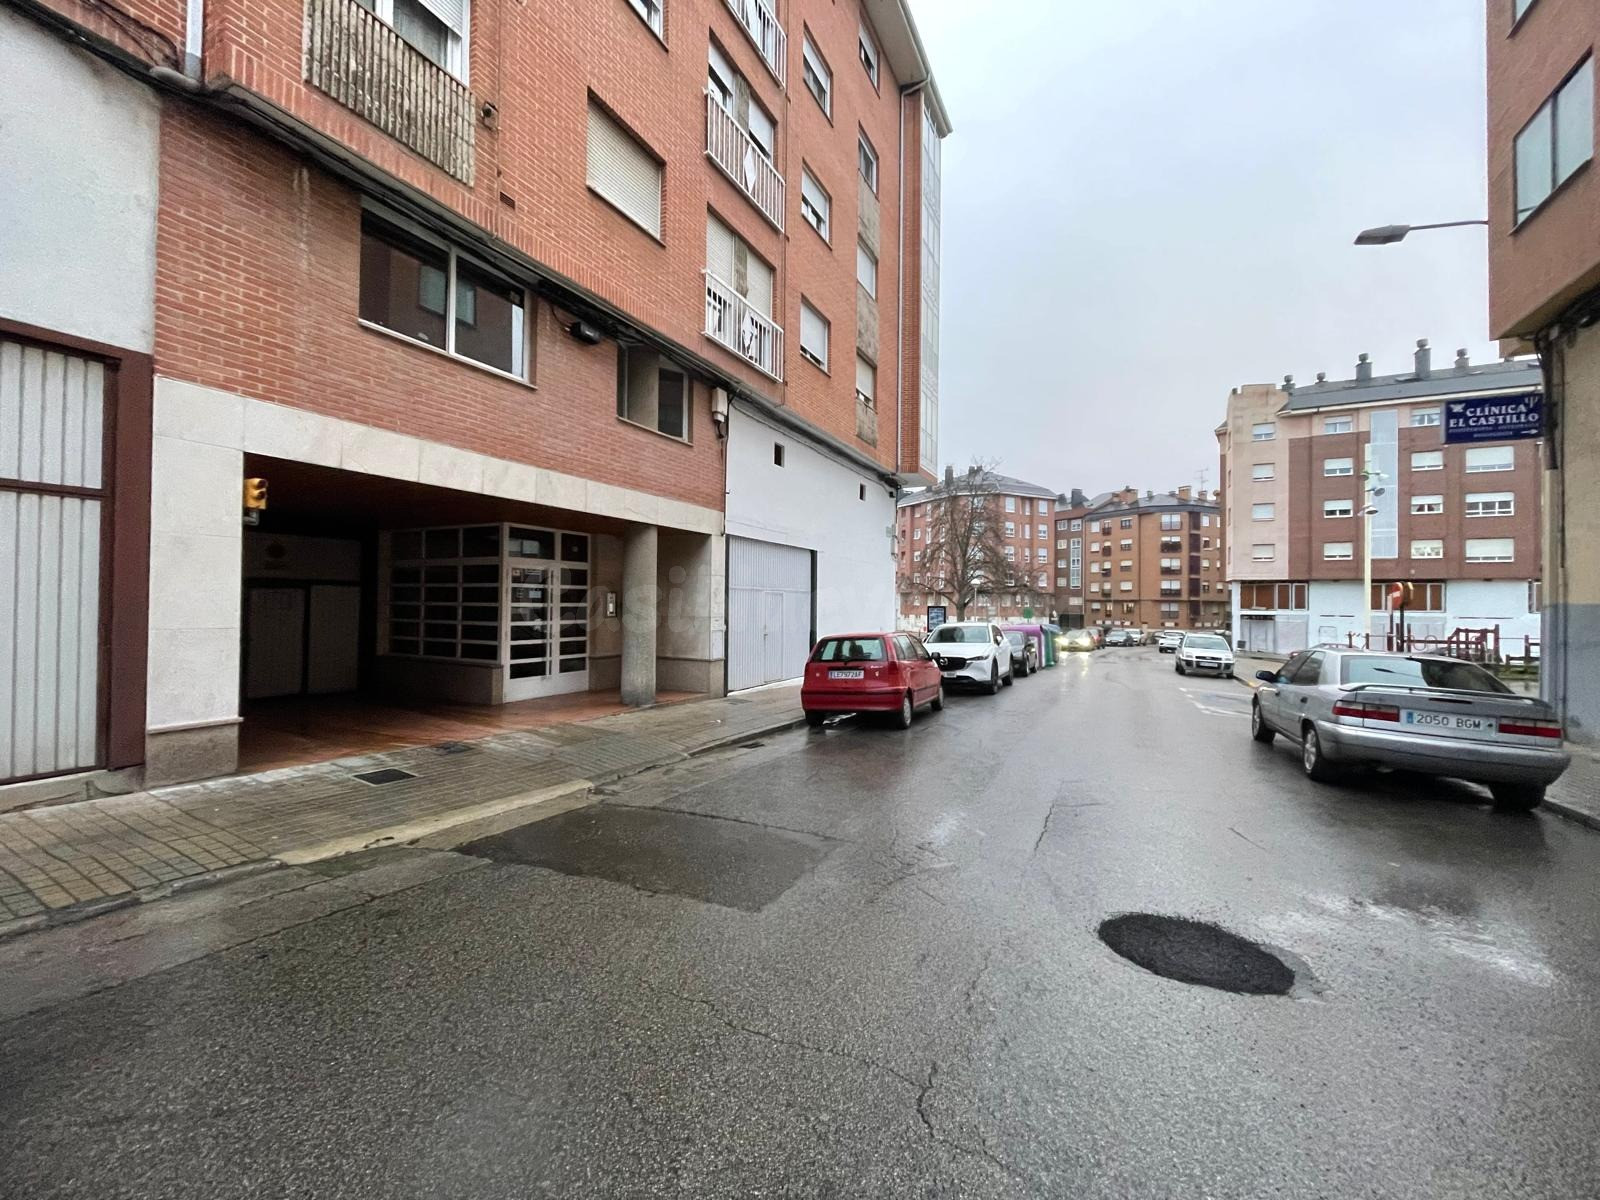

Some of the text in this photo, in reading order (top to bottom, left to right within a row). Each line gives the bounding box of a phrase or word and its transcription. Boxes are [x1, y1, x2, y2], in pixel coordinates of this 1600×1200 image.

[1466, 403, 1527, 417] CLÍNICA
[1449, 418, 1466, 428] EL
[1468, 413, 1539, 426] CASTILLO
[1416, 713, 1481, 728] 2050 BGM
